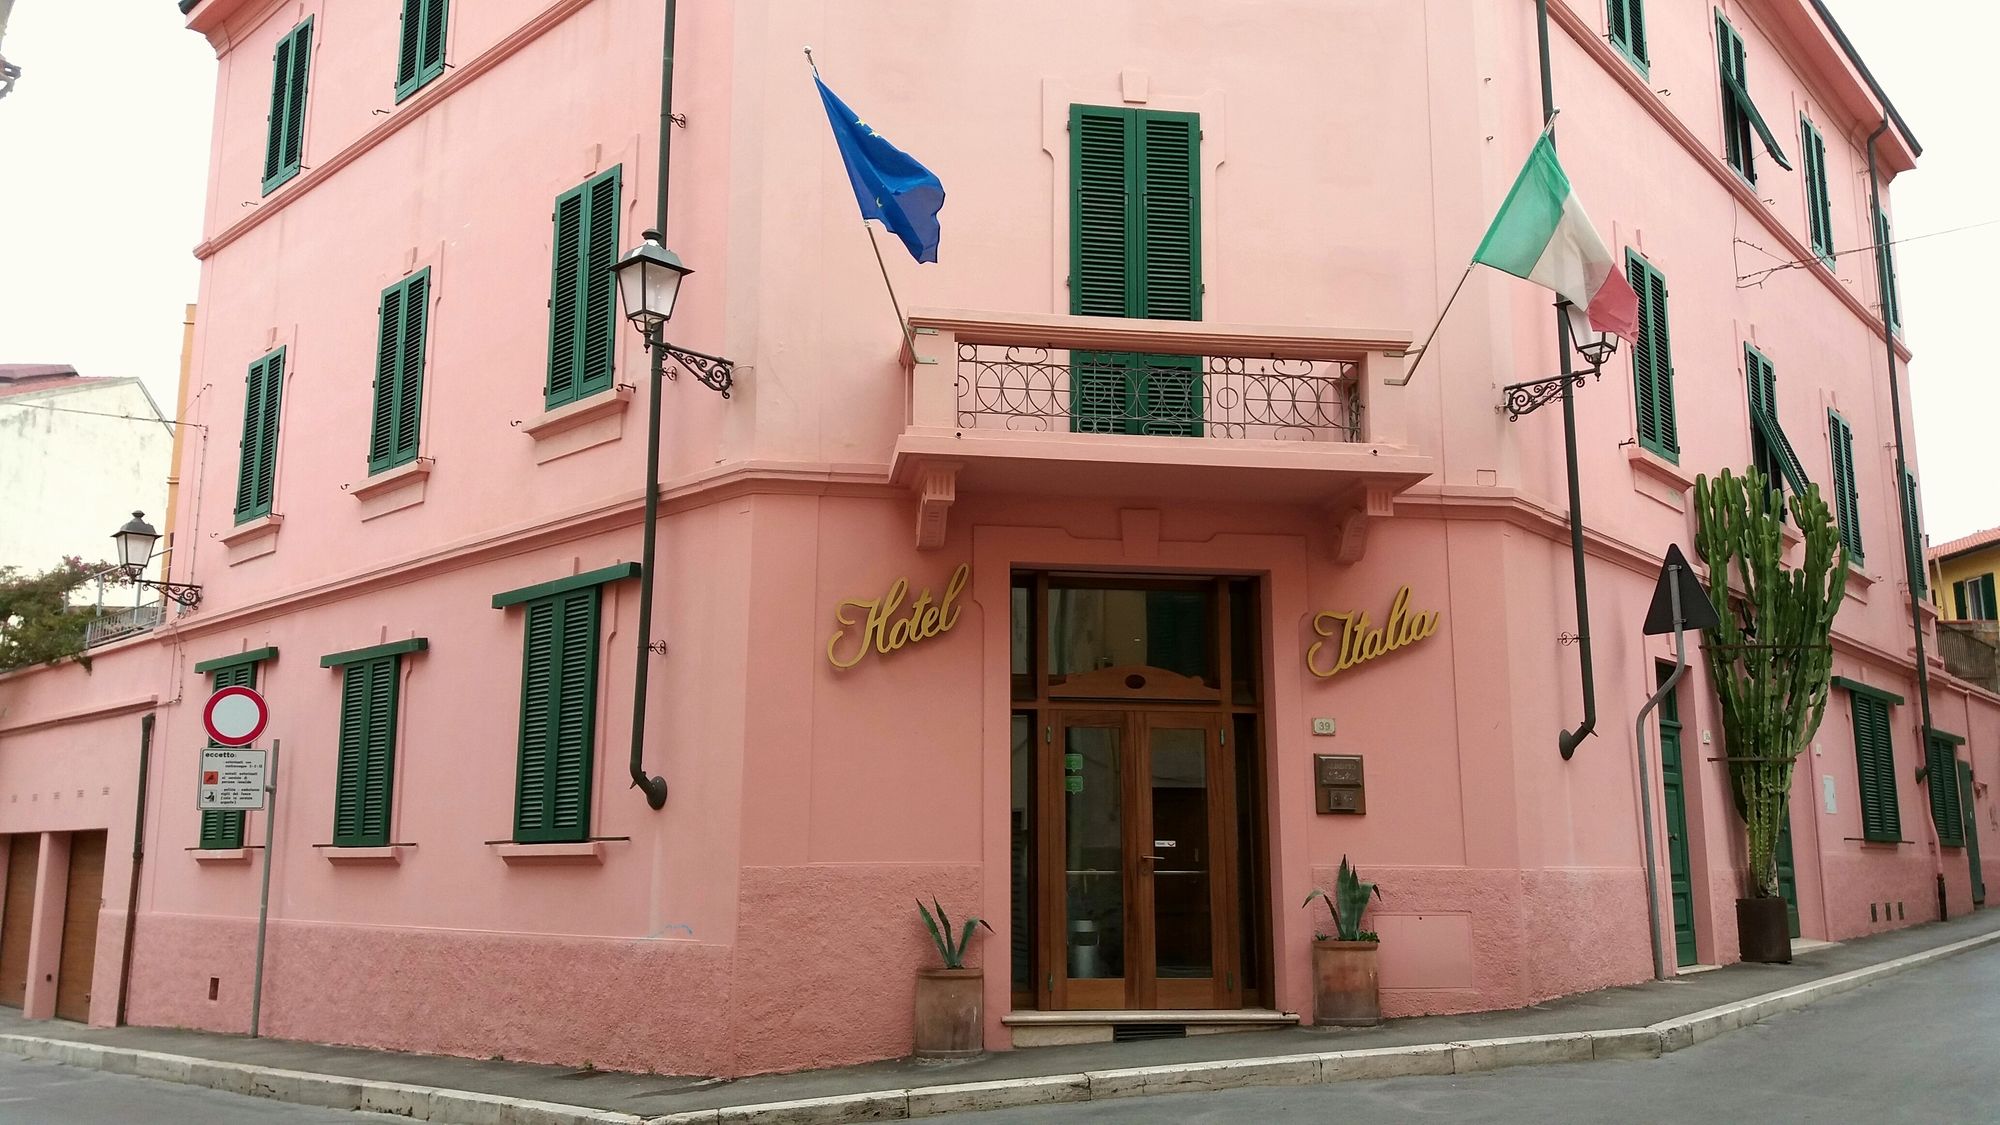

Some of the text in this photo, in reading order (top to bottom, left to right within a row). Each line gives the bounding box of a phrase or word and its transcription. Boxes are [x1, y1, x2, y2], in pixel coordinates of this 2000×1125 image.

[827, 562, 969, 668] Hotel
[1307, 584, 1440, 677] Italia
[1319, 721, 1330, 731] 39
